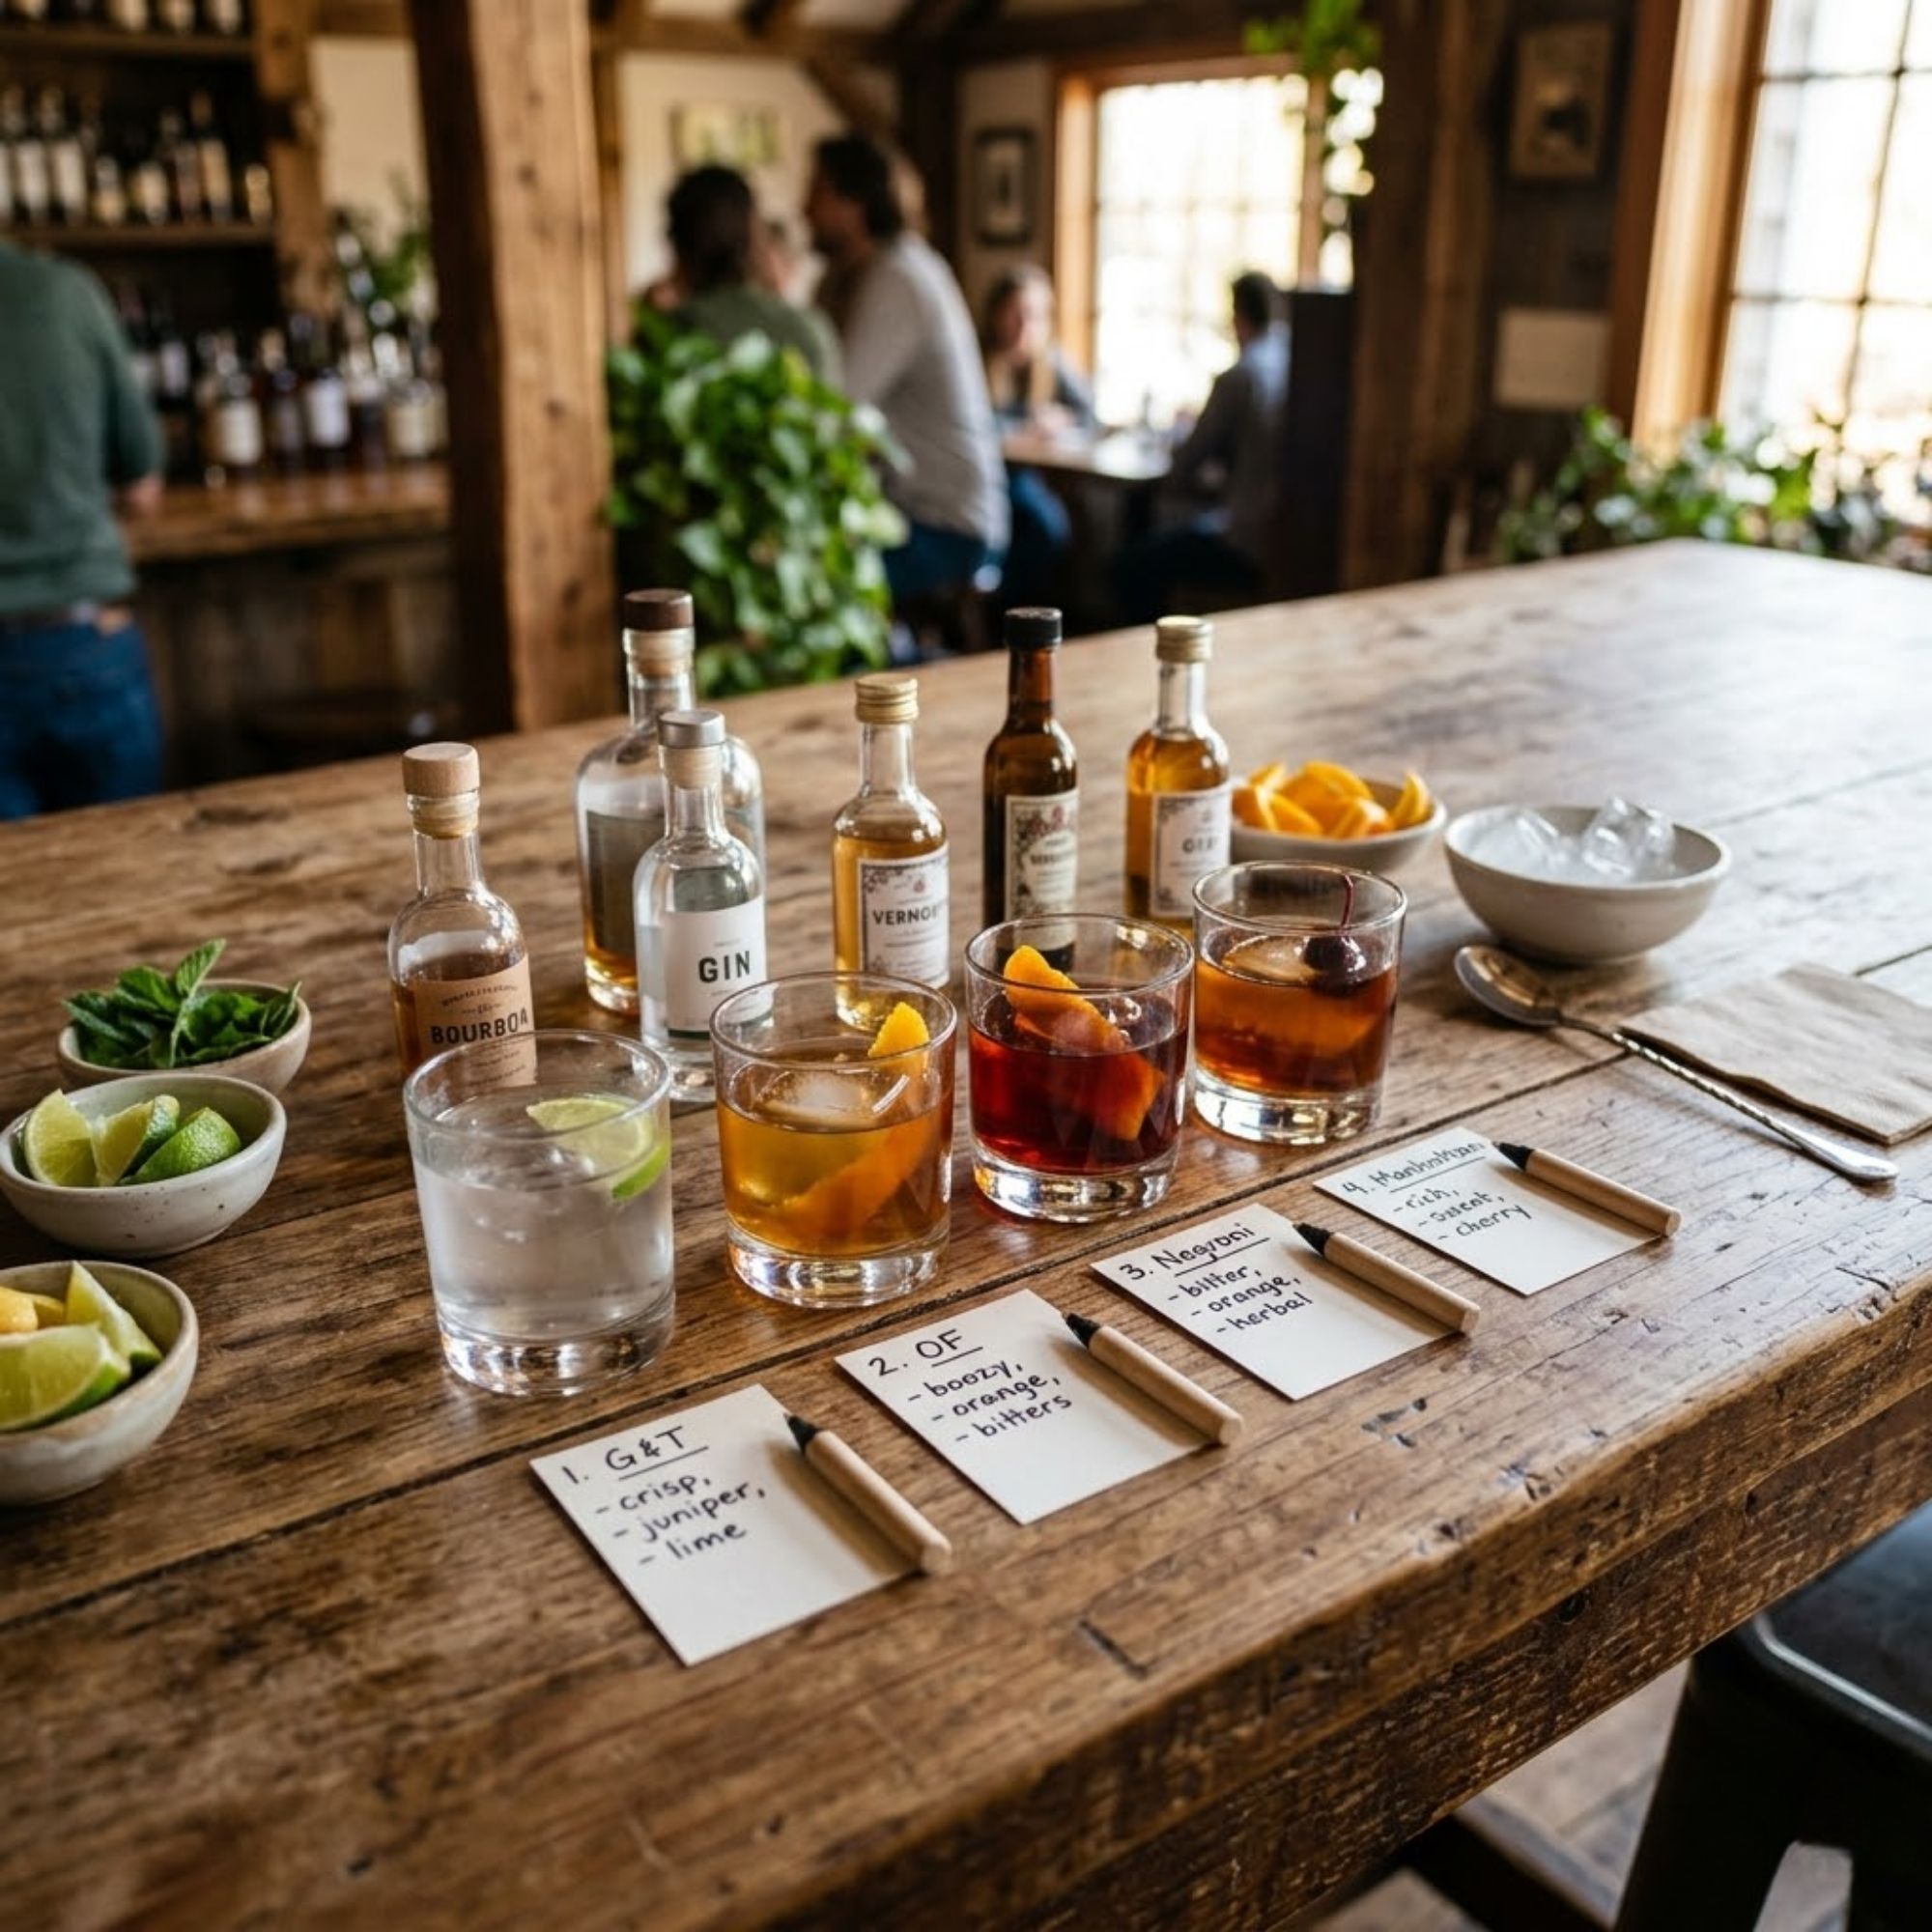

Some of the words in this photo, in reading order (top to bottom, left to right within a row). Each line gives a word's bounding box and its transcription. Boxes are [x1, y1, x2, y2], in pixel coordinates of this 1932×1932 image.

[698, 951, 750, 983] GIN
[1456, 1205, 1532, 1236] cherry
[1119, 1263, 1154, 1281] 3.
[1179, 1265, 1263, 1297] bitter,
[1208, 1274, 1301, 1314] orange,
[1227, 1293, 1314, 1330] herbal
[869, 1357, 908, 1377] 2.
[915, 1328, 962, 1359] OF
[923, 1360, 1023, 1397] boozy,
[952, 1374, 1061, 1417] orange,
[972, 1395, 1072, 1437] bitters
[561, 1465, 588, 1485] 1.
[605, 1426, 683, 1470] G&T
[620, 1475, 711, 1511] crisp,
[639, 1482, 766, 1542] juniper,
[666, 1523, 748, 1560] lime
